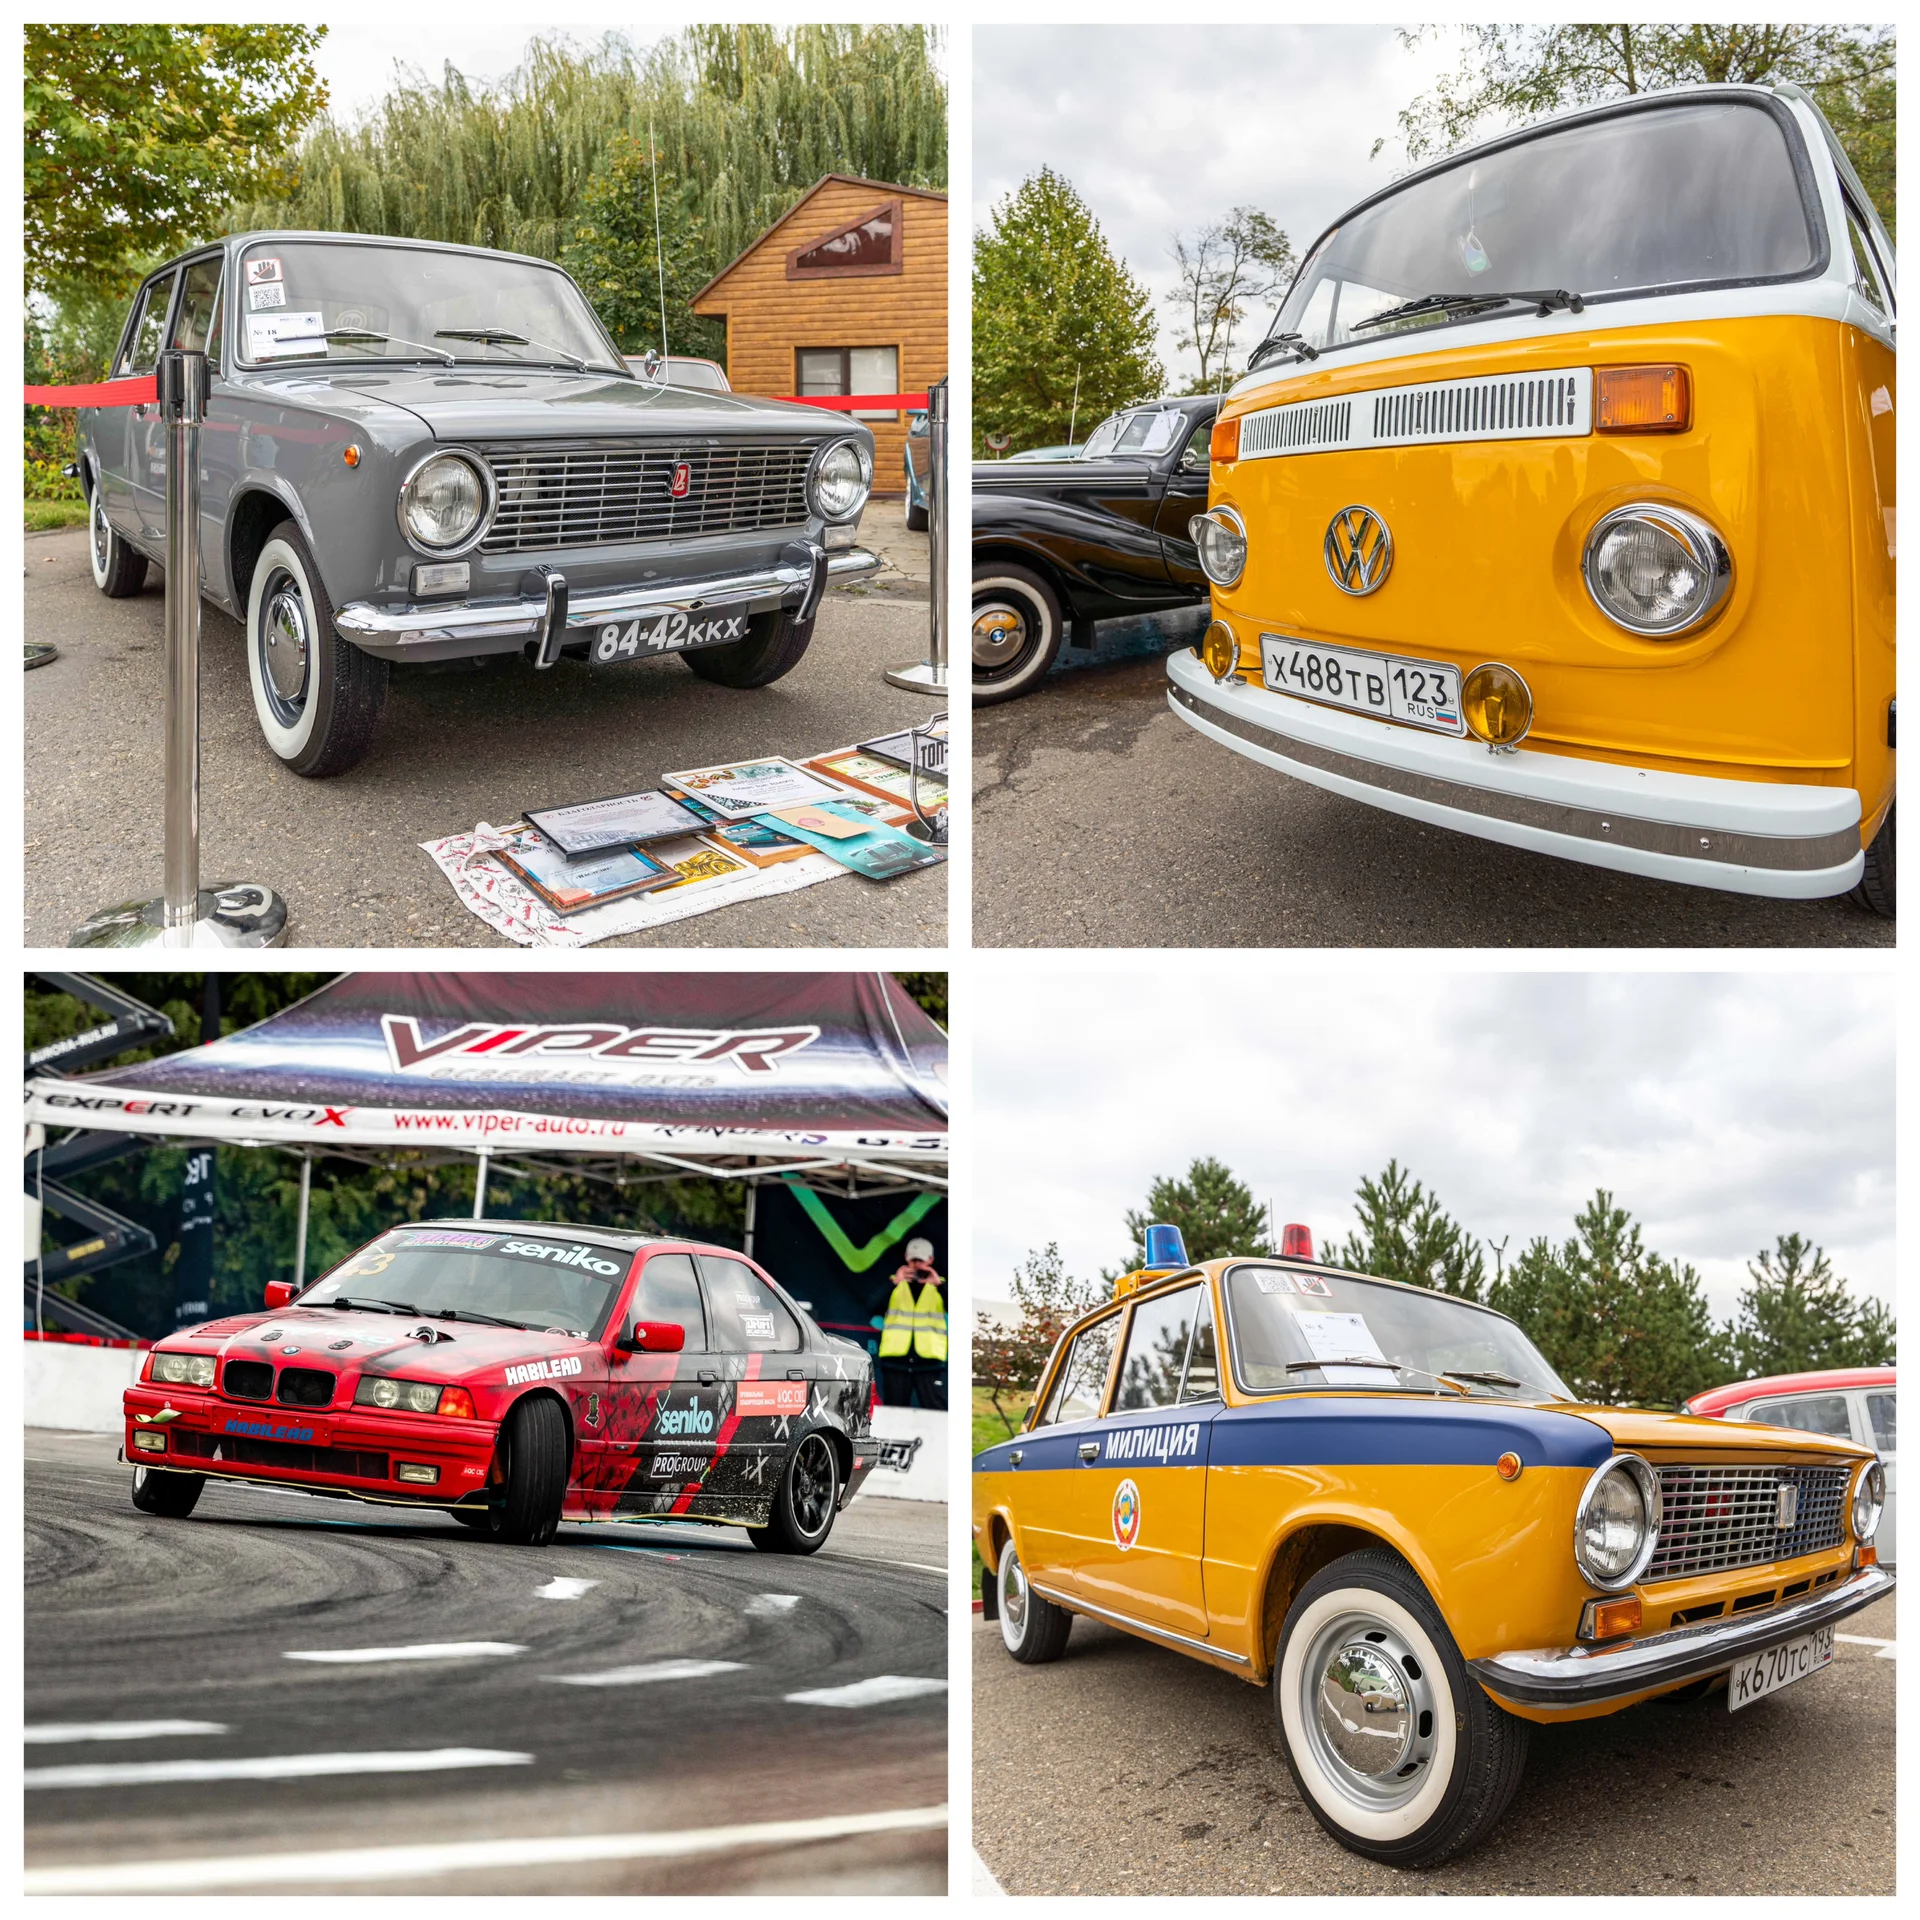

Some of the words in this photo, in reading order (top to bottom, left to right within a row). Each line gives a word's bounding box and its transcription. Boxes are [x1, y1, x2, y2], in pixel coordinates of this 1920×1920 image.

[1393, 667, 1447, 706] 123
[1407, 703, 1435, 719] RUS
[383, 1016, 818, 1074] VIPER
[394, 1112, 627, 1137] www.viper-auto.ru
[499, 1240, 621, 1276] seniko
[504, 1356, 582, 1386] HABILEAD
[224, 1418, 315, 1441] HABILEAD
[660, 1396, 713, 1435] seniko
[1105, 1423, 1200, 1464] МИЛИЦИЯ
[652, 1456, 707, 1472] PROGROUP
[1739, 1644, 1809, 1701] К670ТС
